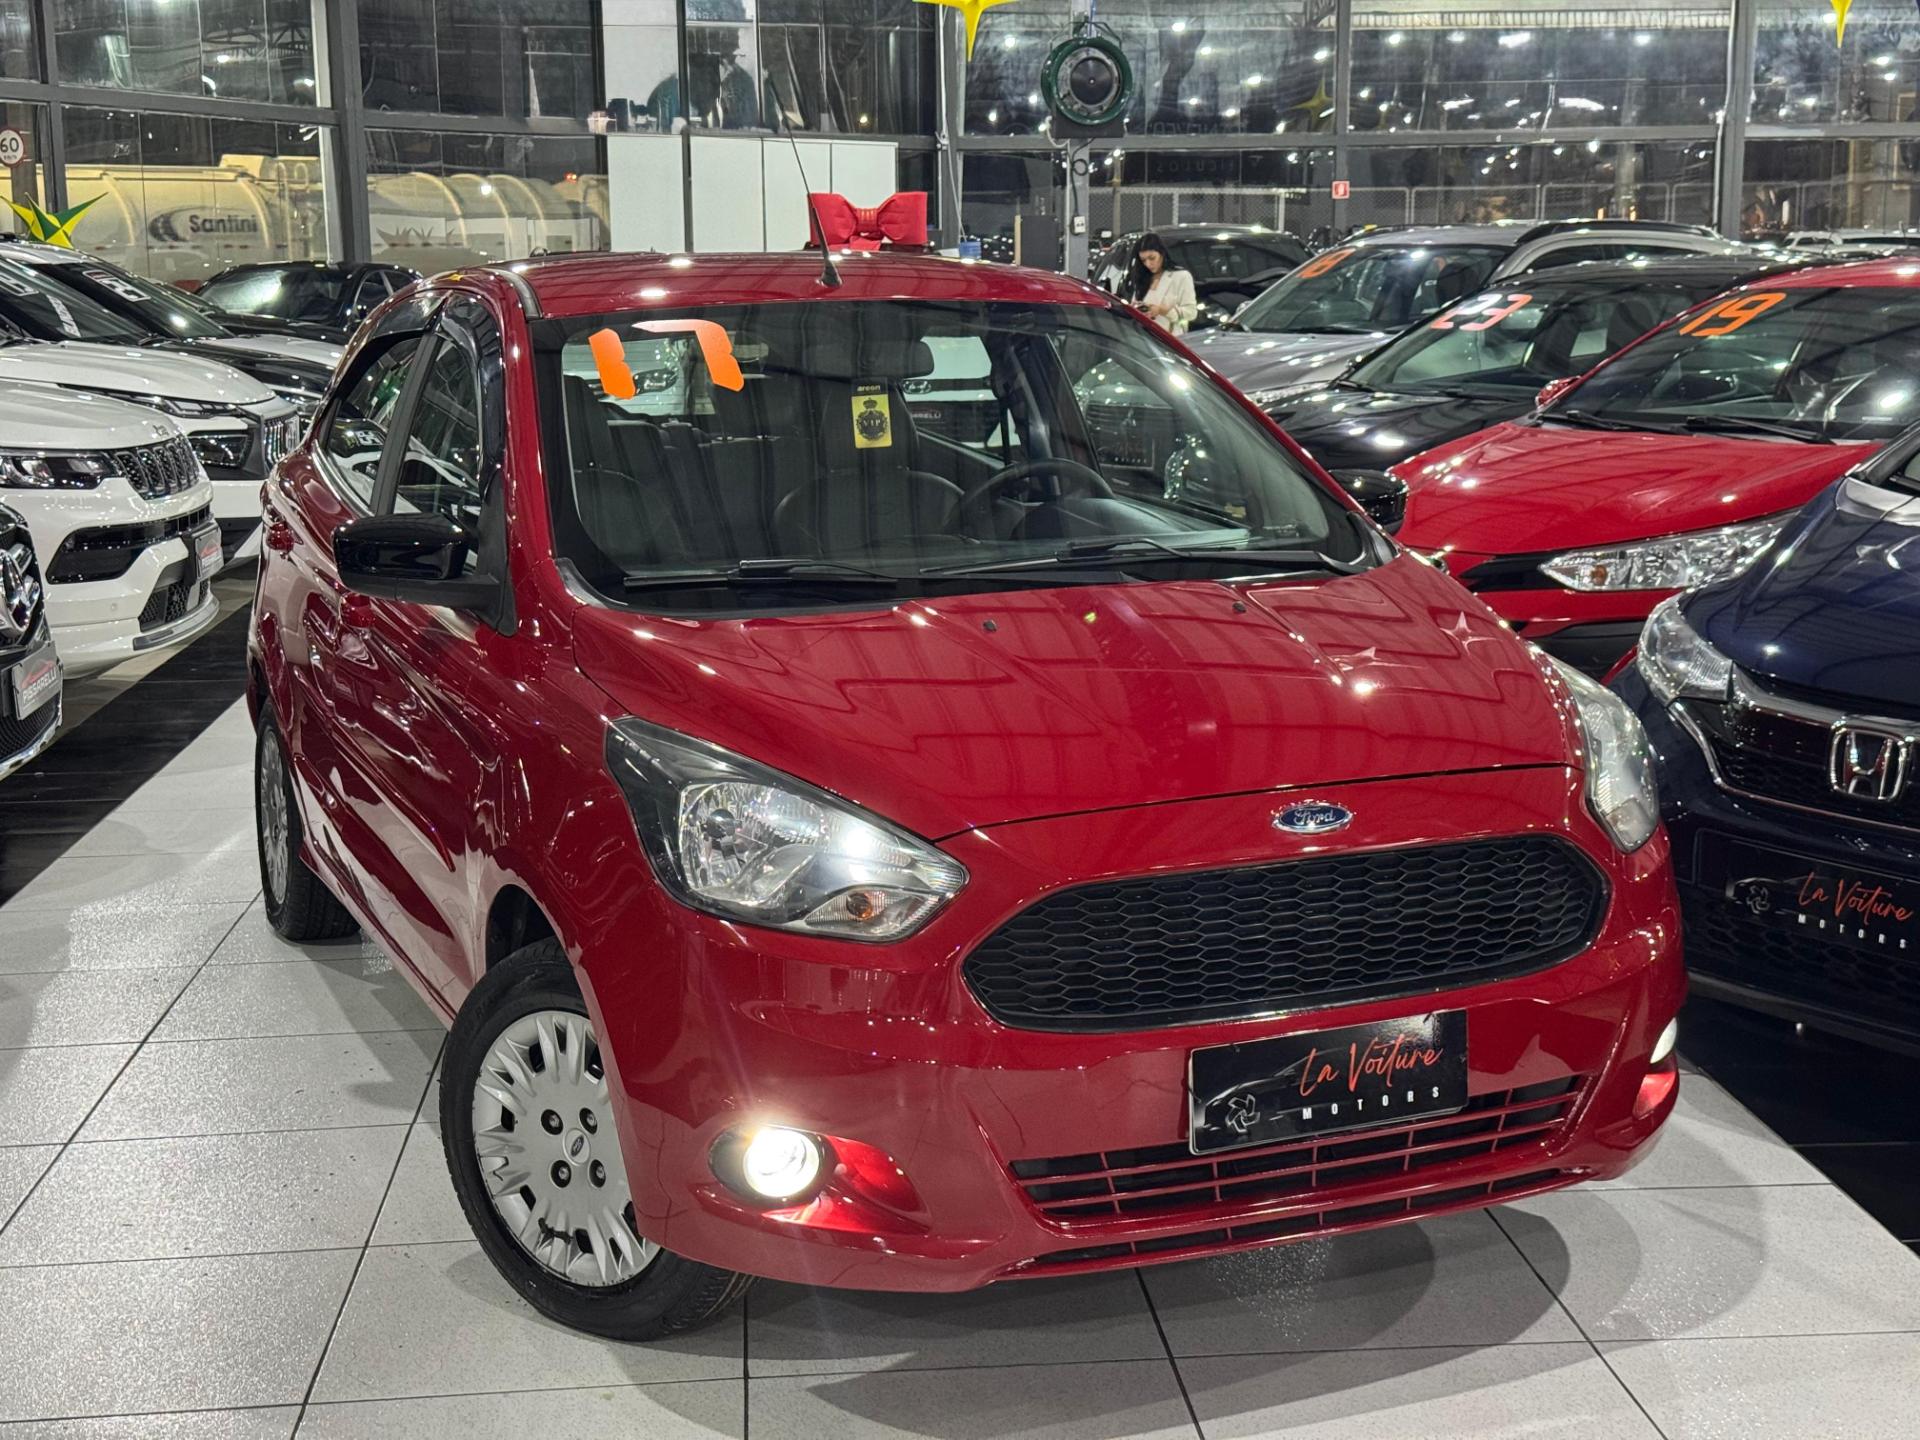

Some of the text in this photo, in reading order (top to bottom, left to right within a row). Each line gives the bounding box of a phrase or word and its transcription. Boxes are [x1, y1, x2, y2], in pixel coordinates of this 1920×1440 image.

[0, 137, 19, 153] 60
[188, 214, 258, 233] Santini
[1430, 293, 1534, 331] 23
[1679, 292, 1788, 337] 19
[588, 318, 745, 401] 17
[863, 419, 881, 427] VIP
[1292, 807, 1338, 826] Ford
[1798, 871, 1915, 926] La Voiture
[1797, 912, 1907, 949] MOTORS
[1299, 1033, 1444, 1097] La Voiture
[1302, 1086, 1440, 1121] MOTORS
